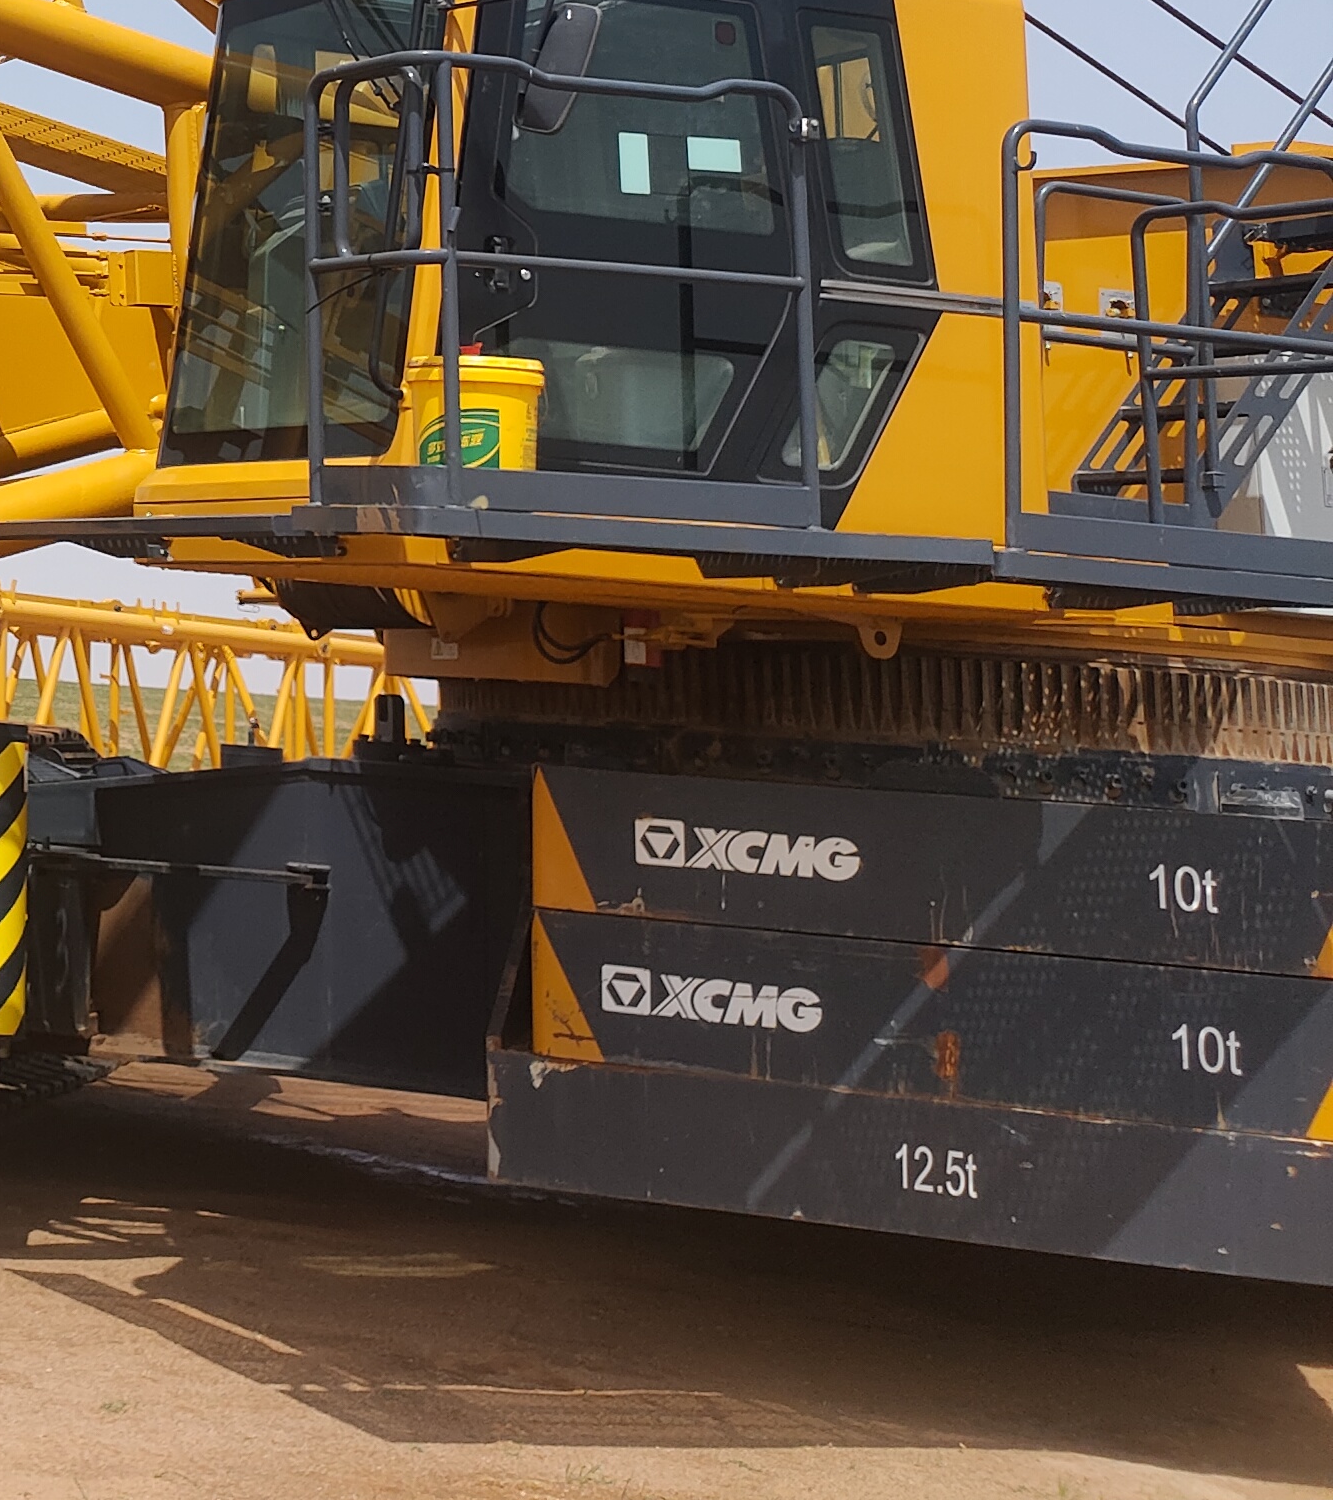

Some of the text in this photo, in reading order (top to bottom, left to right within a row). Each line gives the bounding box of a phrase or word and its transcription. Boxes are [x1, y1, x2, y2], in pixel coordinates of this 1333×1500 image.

[685, 826, 861, 882] XCMG
[1148, 863, 1220, 915] 10t
[650, 973, 823, 1034] XCMG
[1171, 1022, 1243, 1077] 10t
[894, 1142, 979, 1200] 12.5t
